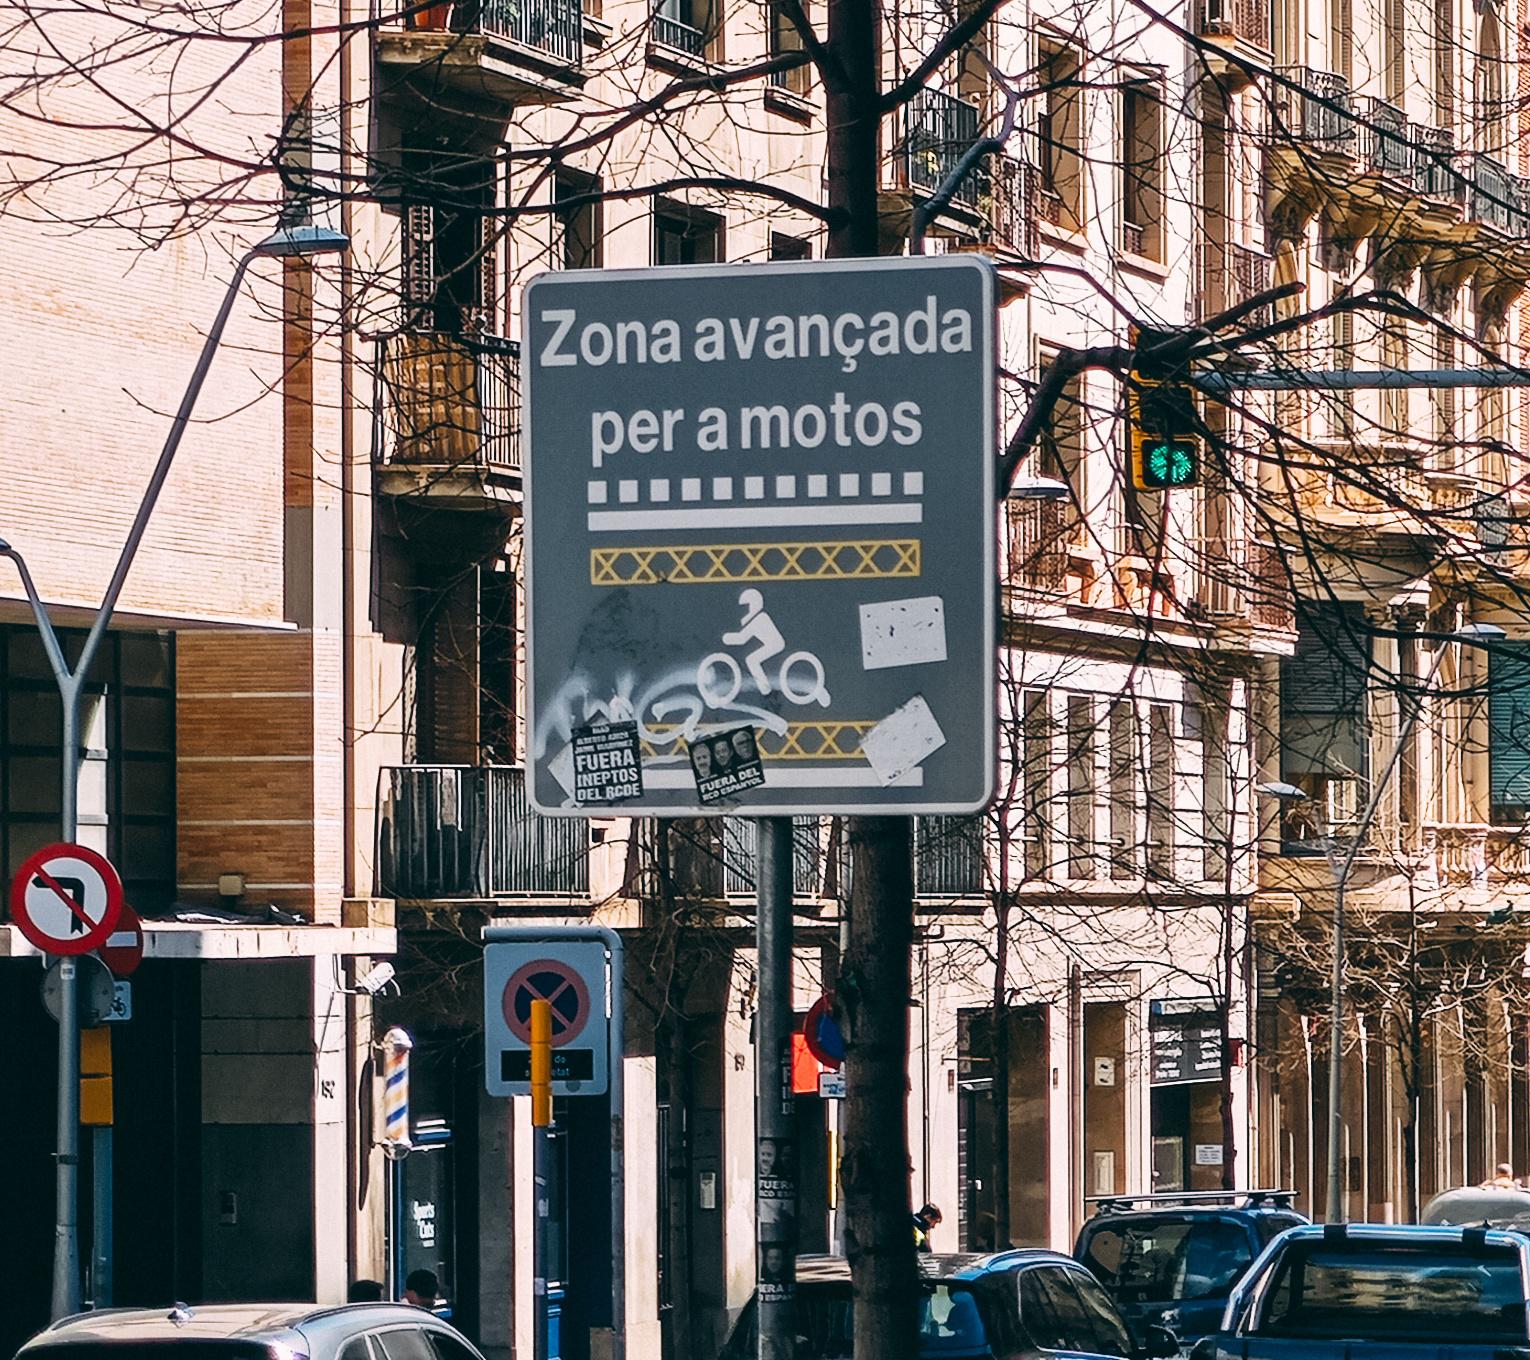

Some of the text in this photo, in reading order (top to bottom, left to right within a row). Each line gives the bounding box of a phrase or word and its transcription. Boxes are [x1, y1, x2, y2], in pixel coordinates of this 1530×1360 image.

[540, 295, 973, 372] Zona avançada
[591, 392, 923, 468] per a motos
[576, 749, 635, 772] FUERA
[577, 767, 638, 787] INEPTOS
[700, 774, 737, 793] FUERA
[738, 767, 760, 781] DEL
[577, 783, 640, 801] DEL RCDE
